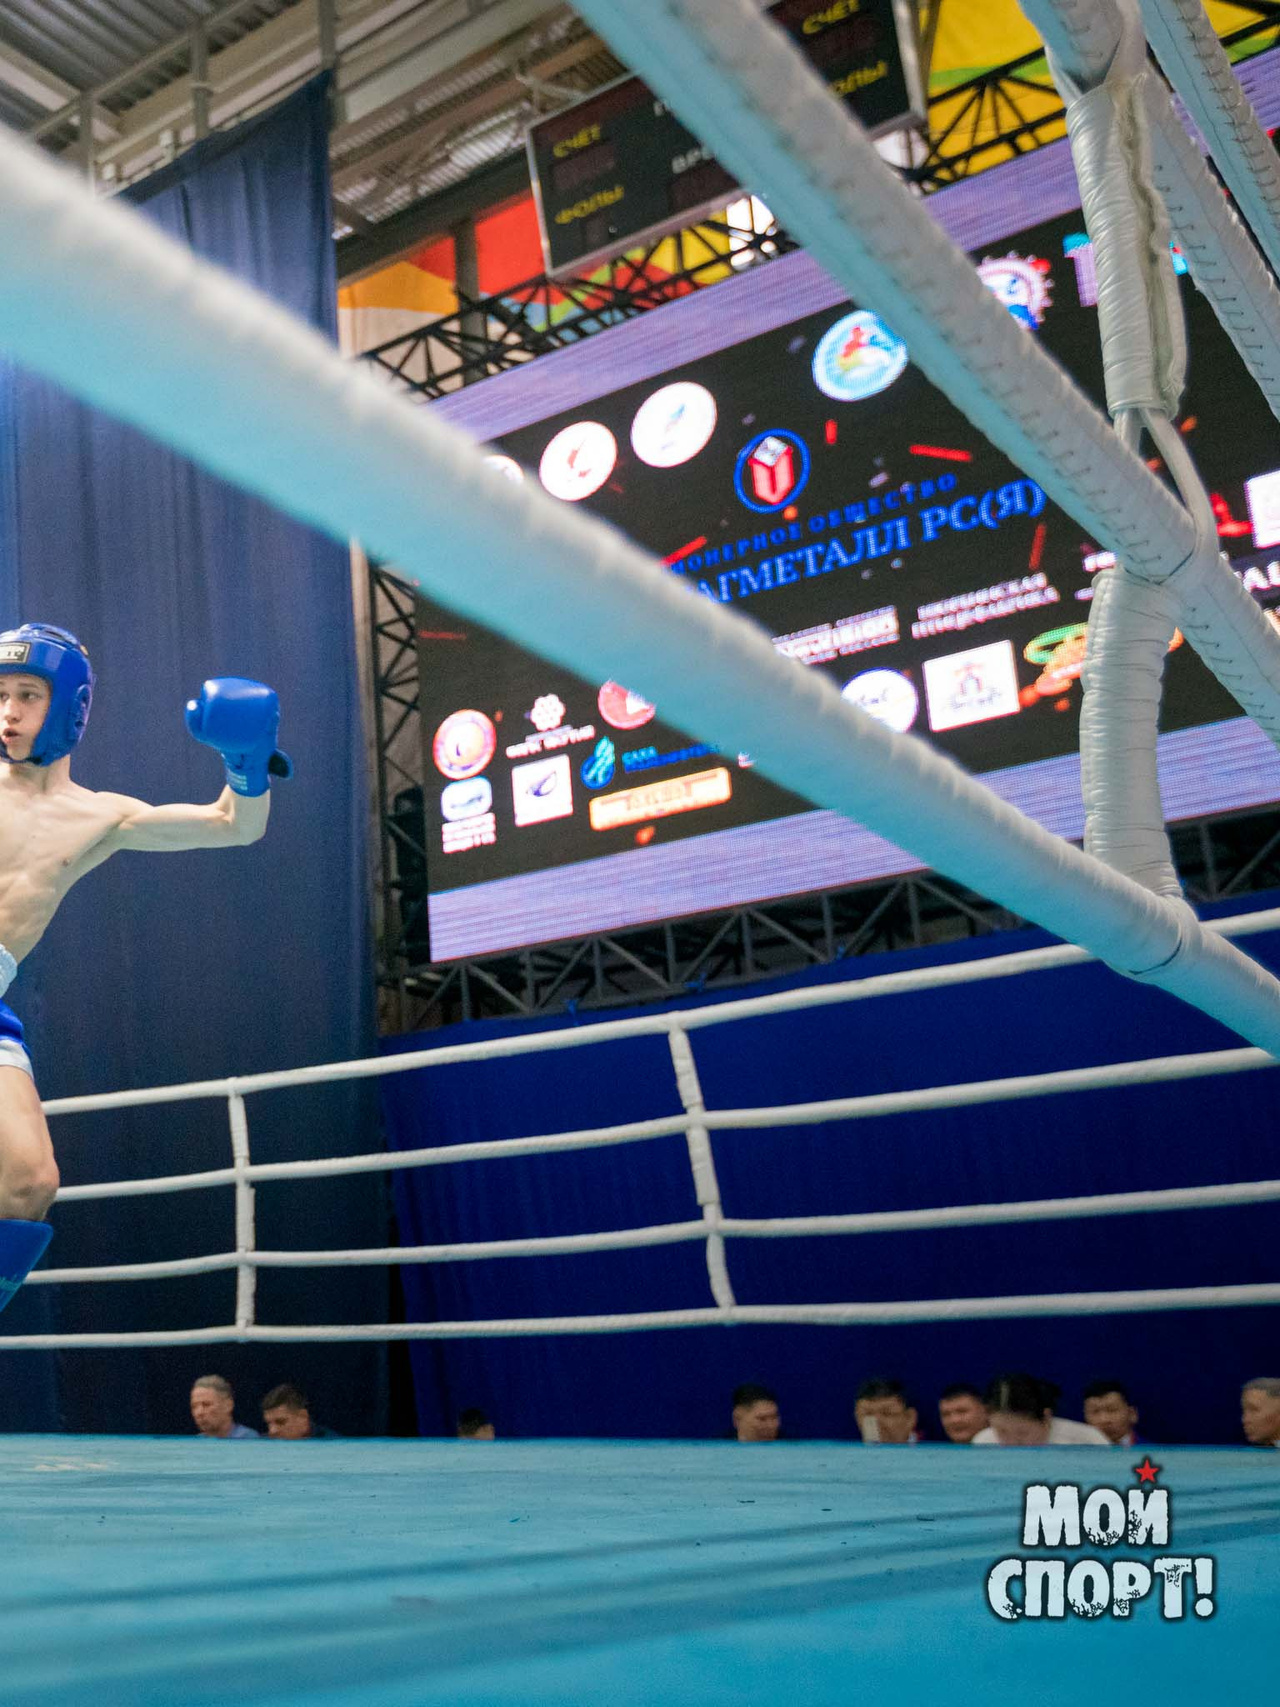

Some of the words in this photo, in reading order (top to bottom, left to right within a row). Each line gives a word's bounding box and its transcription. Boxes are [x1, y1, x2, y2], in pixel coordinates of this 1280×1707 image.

[830, 60, 887, 97] ОЛЫ
[671, 522, 801, 574] ИОНЕРНОЕ
[809, 473, 957, 533] ОБЩЕСТВО
[695, 515, 912, 603] АГМЕТАЛЛ
[920, 478, 1047, 542] РС(Я)
